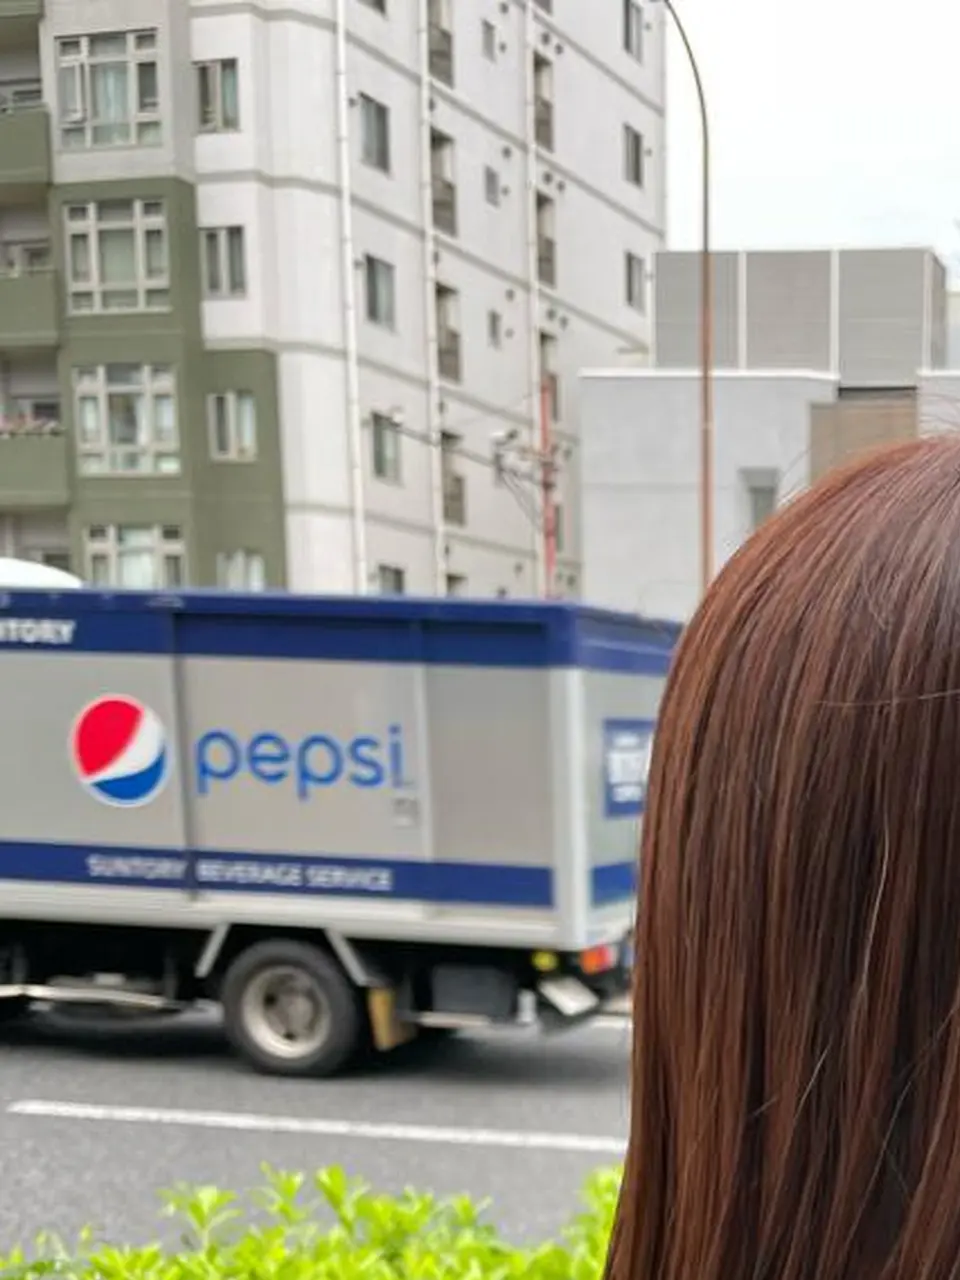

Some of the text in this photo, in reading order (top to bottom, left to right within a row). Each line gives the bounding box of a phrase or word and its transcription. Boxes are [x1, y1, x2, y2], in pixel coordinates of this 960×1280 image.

[0, 618, 76, 644] TORY
[196, 724, 403, 799] pepsi
[85, 853, 394, 891] SUNTORY BEVERAGE SERVICE
